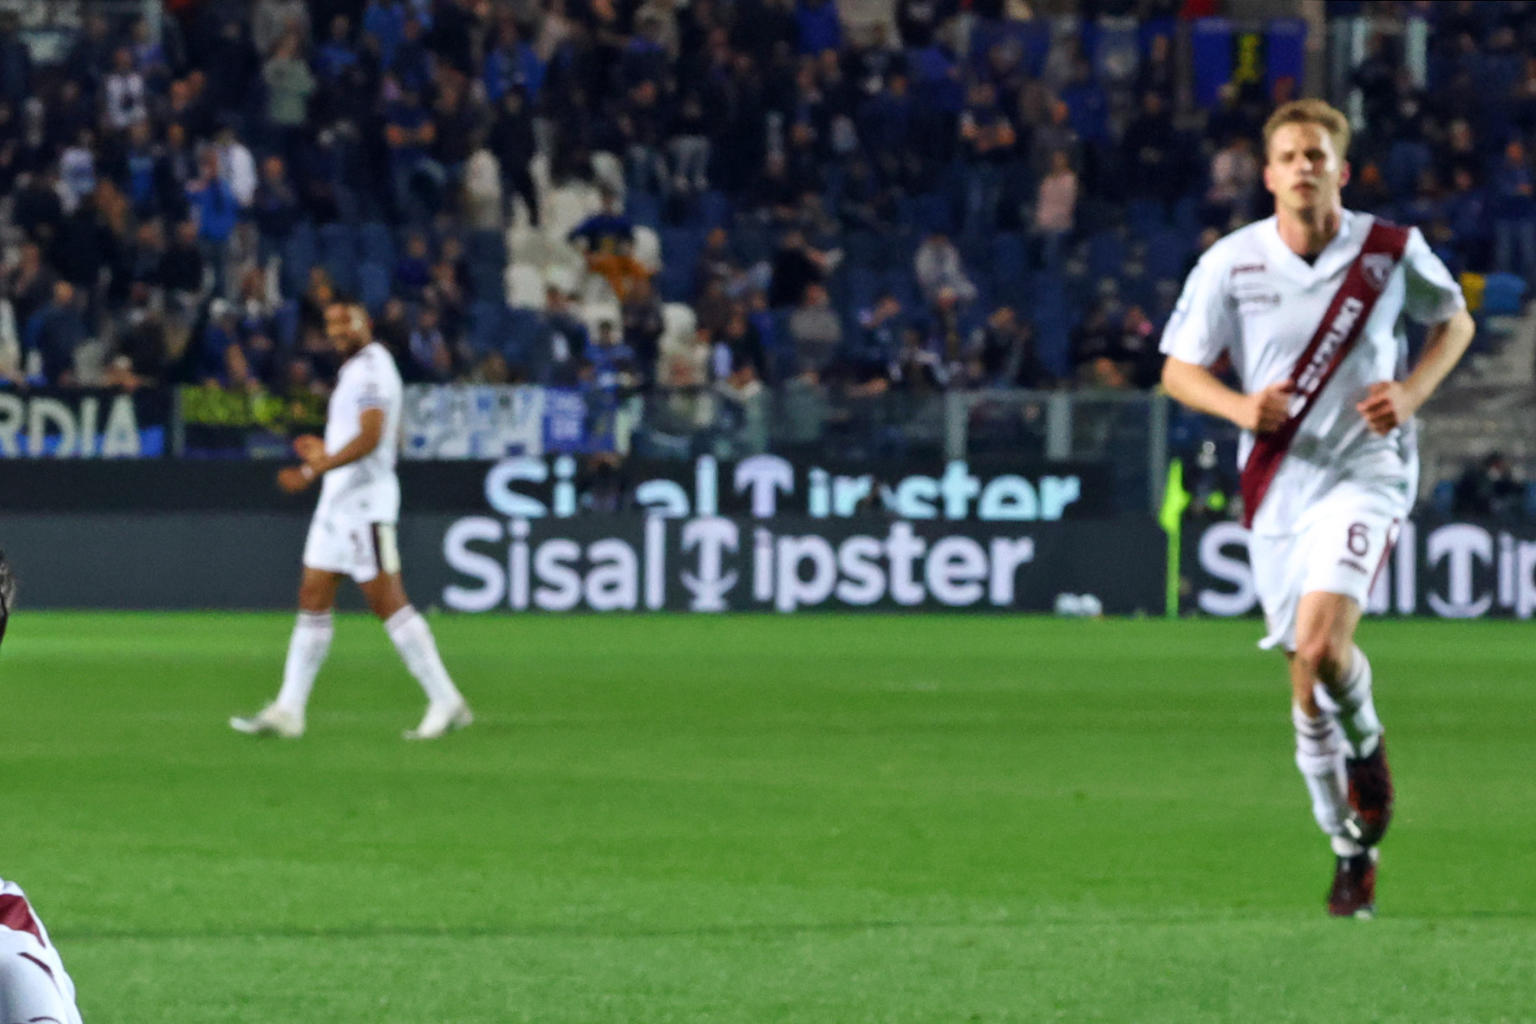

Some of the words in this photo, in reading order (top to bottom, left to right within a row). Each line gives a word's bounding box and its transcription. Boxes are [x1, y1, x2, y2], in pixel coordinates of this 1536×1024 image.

[484, 455, 718, 518] Sial
[734, 454, 1081, 521] Tister
[443, 513, 667, 612] Sisal
[1347, 522, 1370, 557] 6
